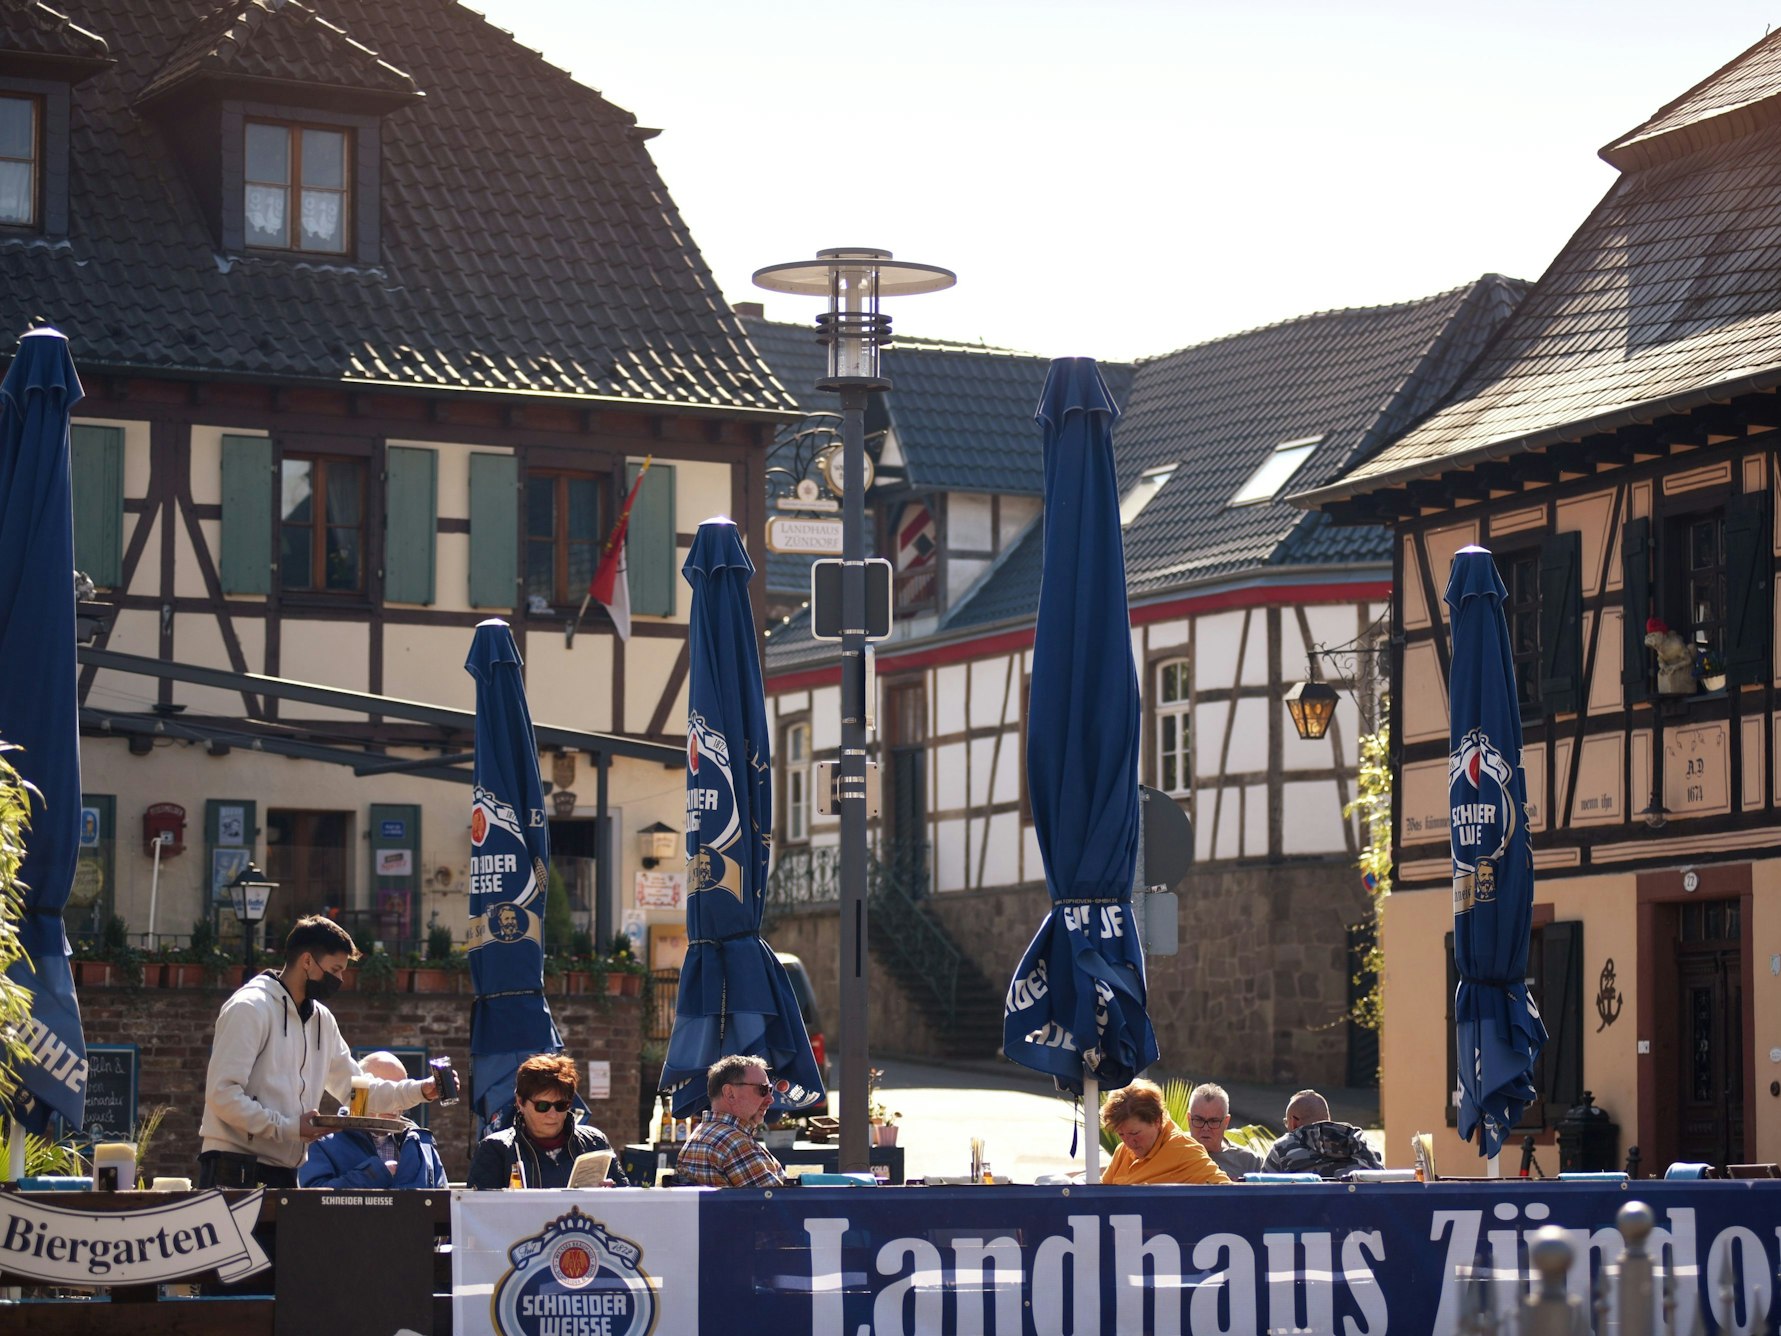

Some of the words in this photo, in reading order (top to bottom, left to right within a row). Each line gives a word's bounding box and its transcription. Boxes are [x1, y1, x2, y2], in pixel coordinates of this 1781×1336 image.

[781, 523, 839, 535] LANDHAUS
[785, 536, 838, 548] ZÜNDORF
[321, 1196, 363, 1205] SCHNEIDER
[365, 1197, 394, 1205] WEISSE
[2, 1214, 221, 1275] Biergarten
[803, 1214, 1389, 1336] Landhaus
[522, 1294, 627, 1316] SCHNEIDER
[539, 1316, 613, 1336] WEISSE
